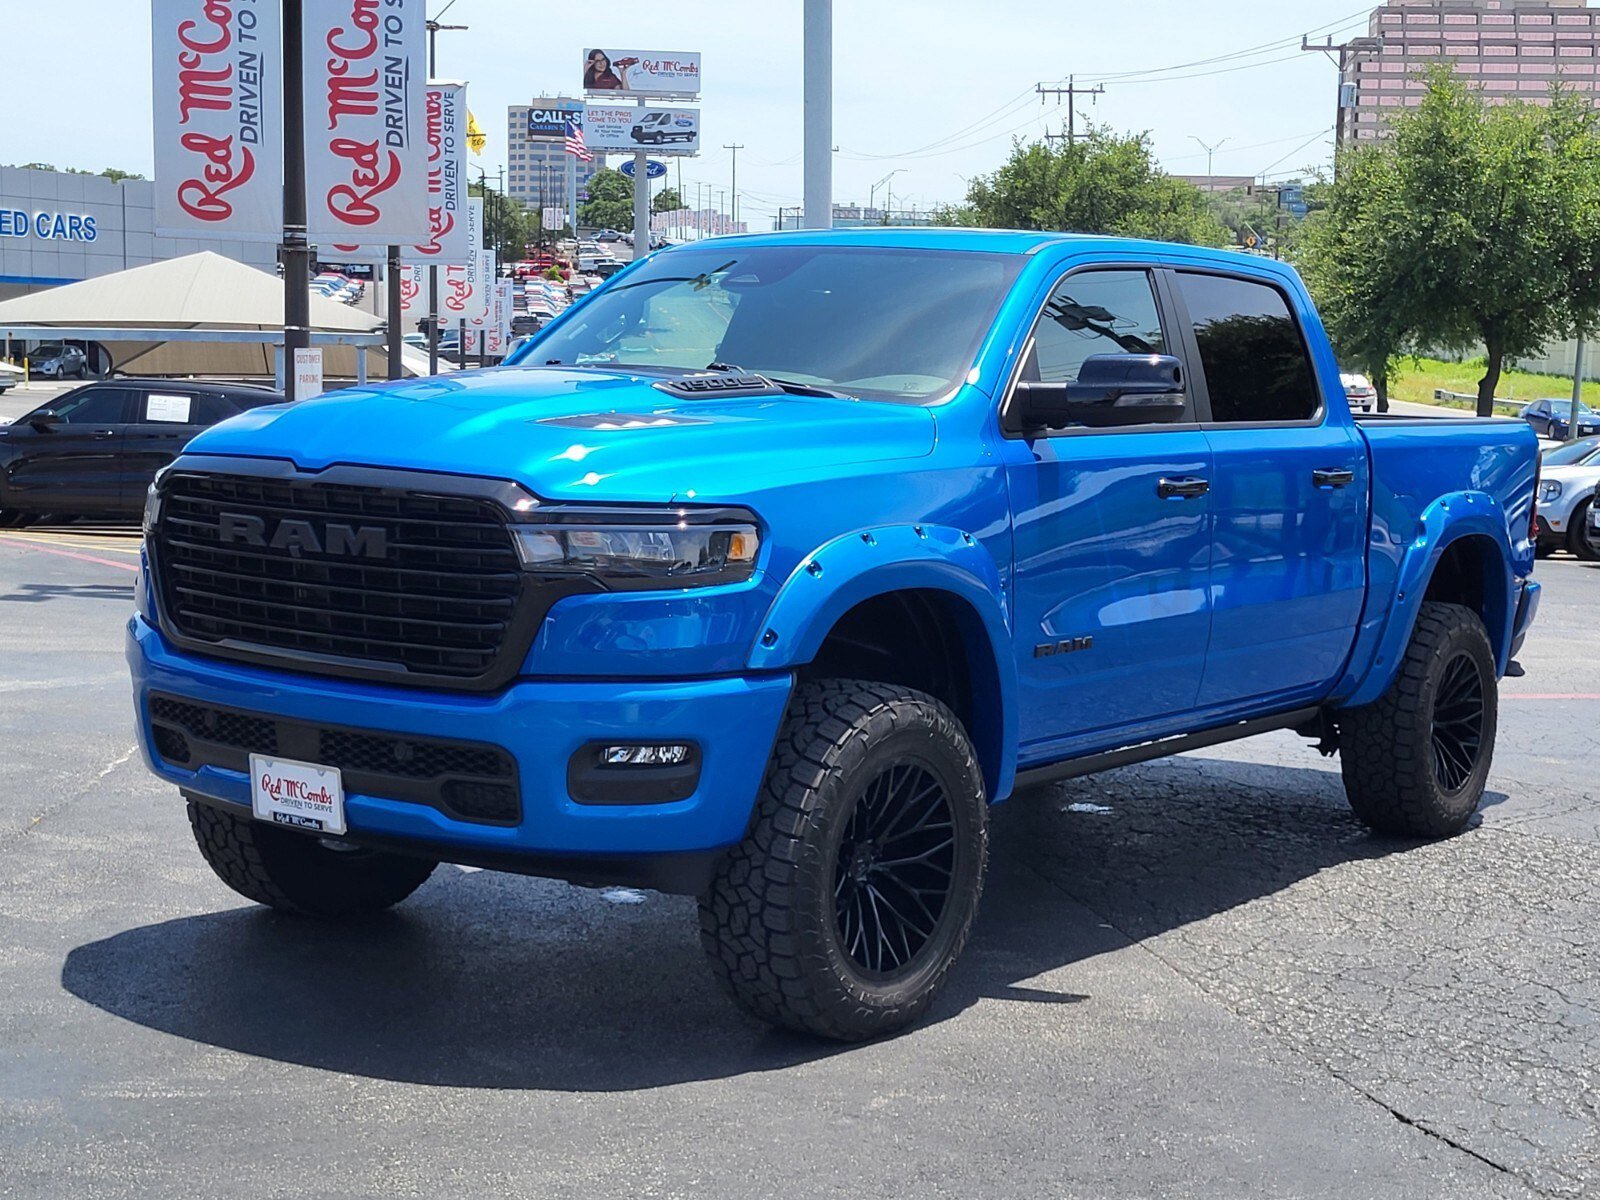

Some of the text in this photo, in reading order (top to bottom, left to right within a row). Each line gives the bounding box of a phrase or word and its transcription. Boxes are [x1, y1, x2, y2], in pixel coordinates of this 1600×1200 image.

[238, 10, 257, 42] TO
[384, 15, 403, 47] TO
[642, 59, 659, 74] Red
[661, 61, 698, 73] McCombs
[178, 0, 255, 221] Red McCo
[239, 51, 258, 145] DRIVEN
[385, 55, 404, 148] DRIVEN
[444, 92, 456, 211] DRIVEN TO SERVE
[327, 138, 401, 225] Red
[36, 212, 97, 241] CARS
[446, 279, 473, 311] Red
[219, 512, 387, 559] RAM
[1033, 635, 1093, 659] RAM
[262, 773, 332, 805] Red McCombs
[281, 797, 332, 813] DRIVEN TO SERVE
